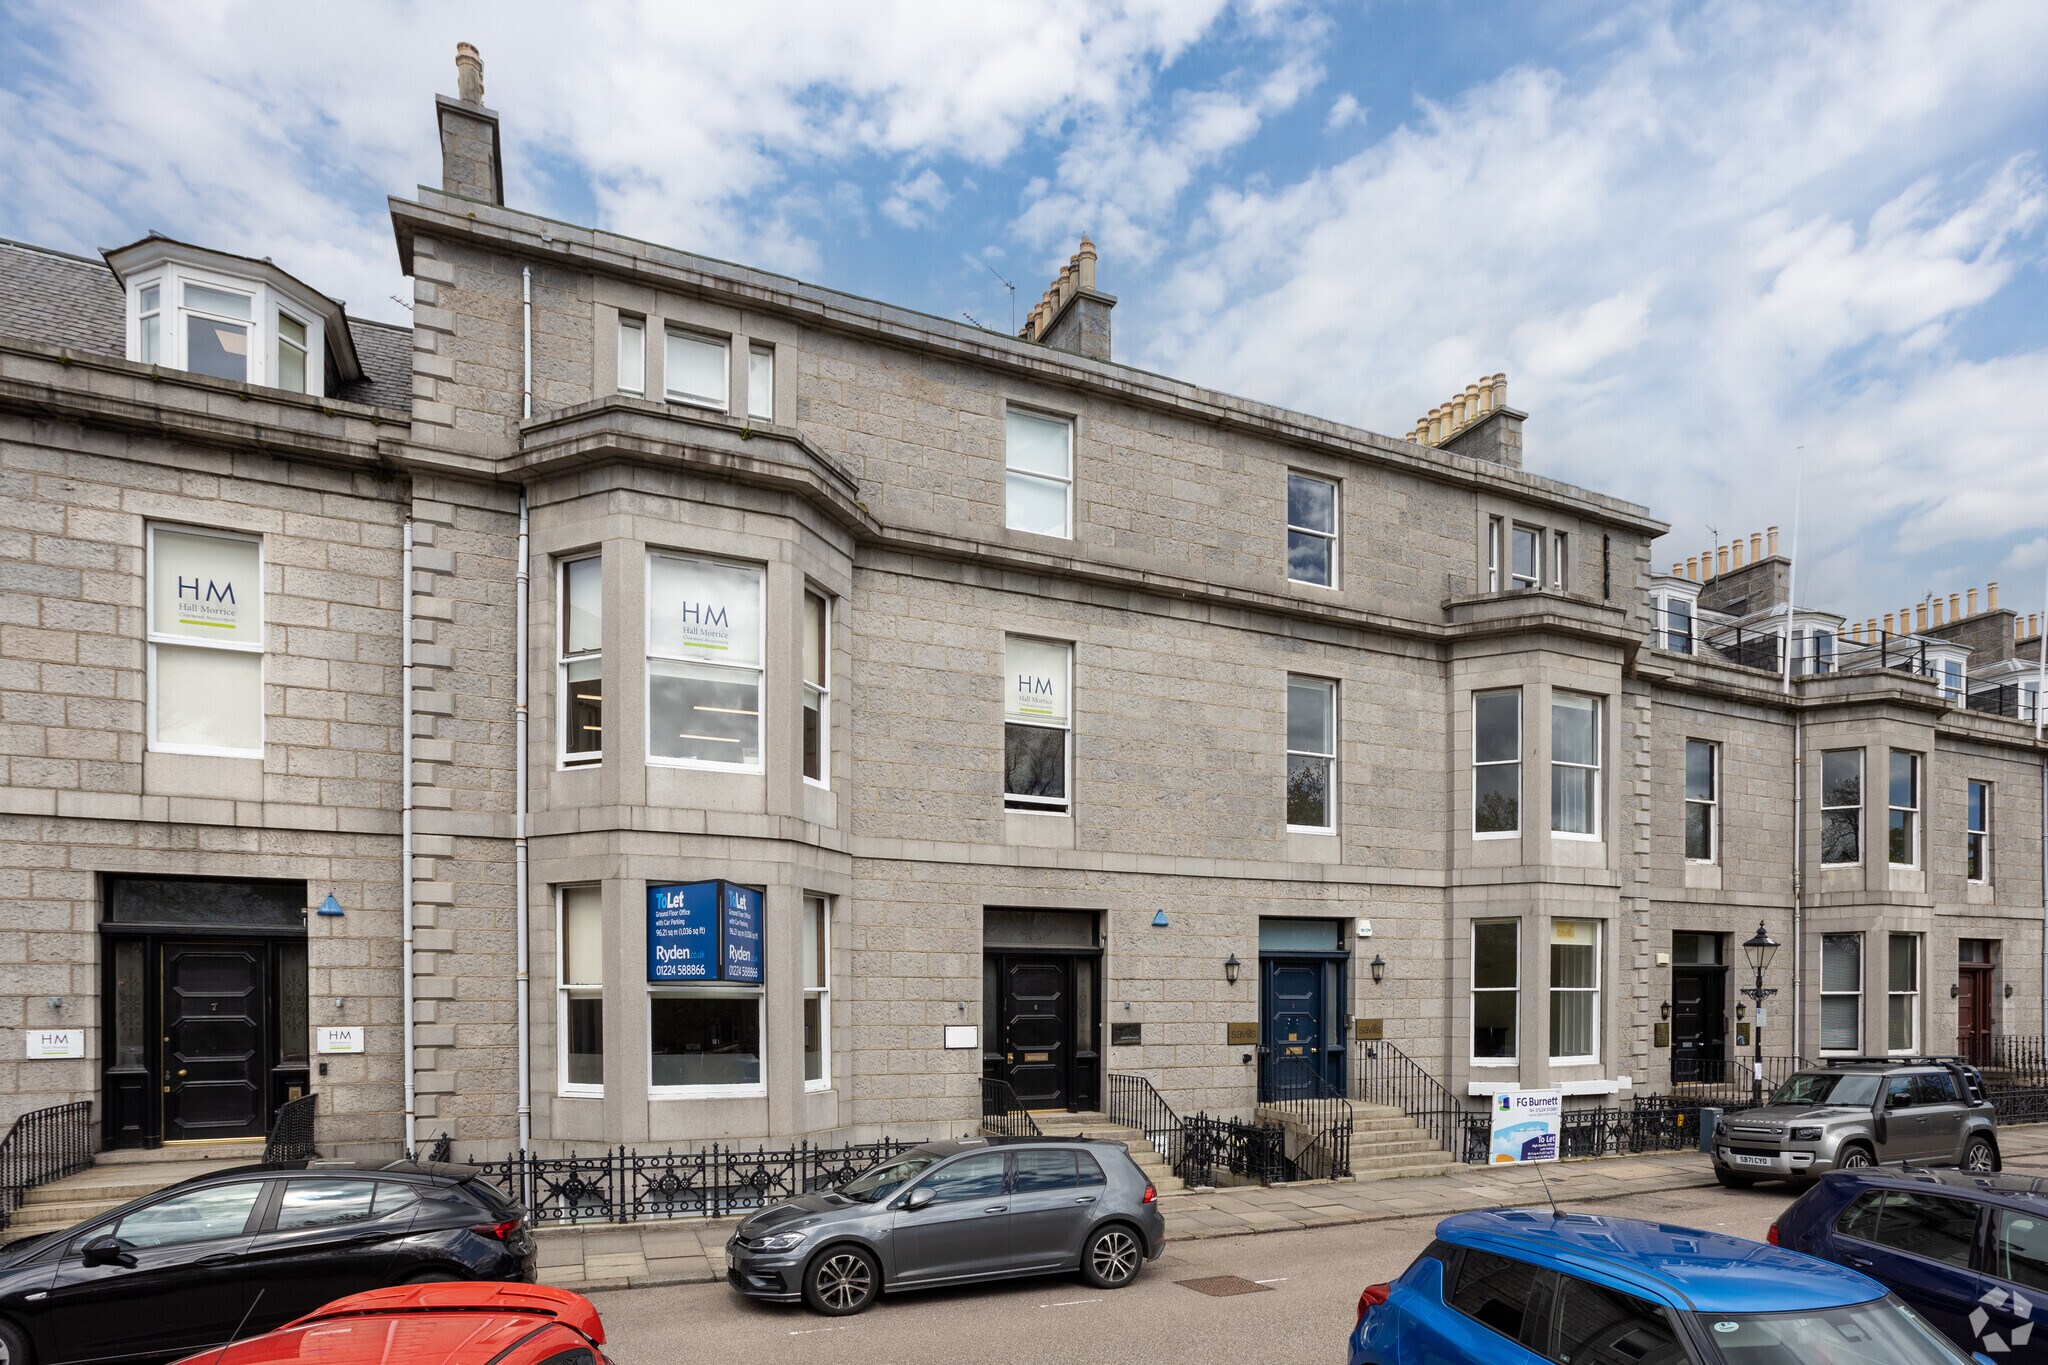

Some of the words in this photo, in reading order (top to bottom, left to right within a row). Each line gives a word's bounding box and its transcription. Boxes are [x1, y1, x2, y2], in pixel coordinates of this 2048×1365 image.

[179, 576, 236, 605] HM
[179, 603, 197, 611] Hall
[200, 605, 236, 616] Morrice
[683, 601, 728, 628] HM
[683, 626, 698, 634] Hall
[700, 629, 728, 639] Morrice
[1019, 674, 1053, 696] HM
[656, 910, 668, 918] Ground
[671, 919, 685, 927] Parking
[656, 929, 668, 937] 96.21
[692, 928, 699, 936] sq
[656, 965, 676, 976] 01224
[677, 964, 706, 976] 588866
[728, 965, 742, 976] 01224
[741, 966, 758, 978] 588866
[211, 1002, 219, 1011] 7
[1231, 1027, 1257, 1039] savills
[1358, 1024, 1381, 1035] savills
[1516, 1097, 1528, 1107] FG
[1529, 1096, 1558, 1107] Burnett
[1546, 1135, 1556, 1143] Let
[1740, 1156, 1754, 1164] SB71
[1754, 1157, 1768, 1165] CYO
